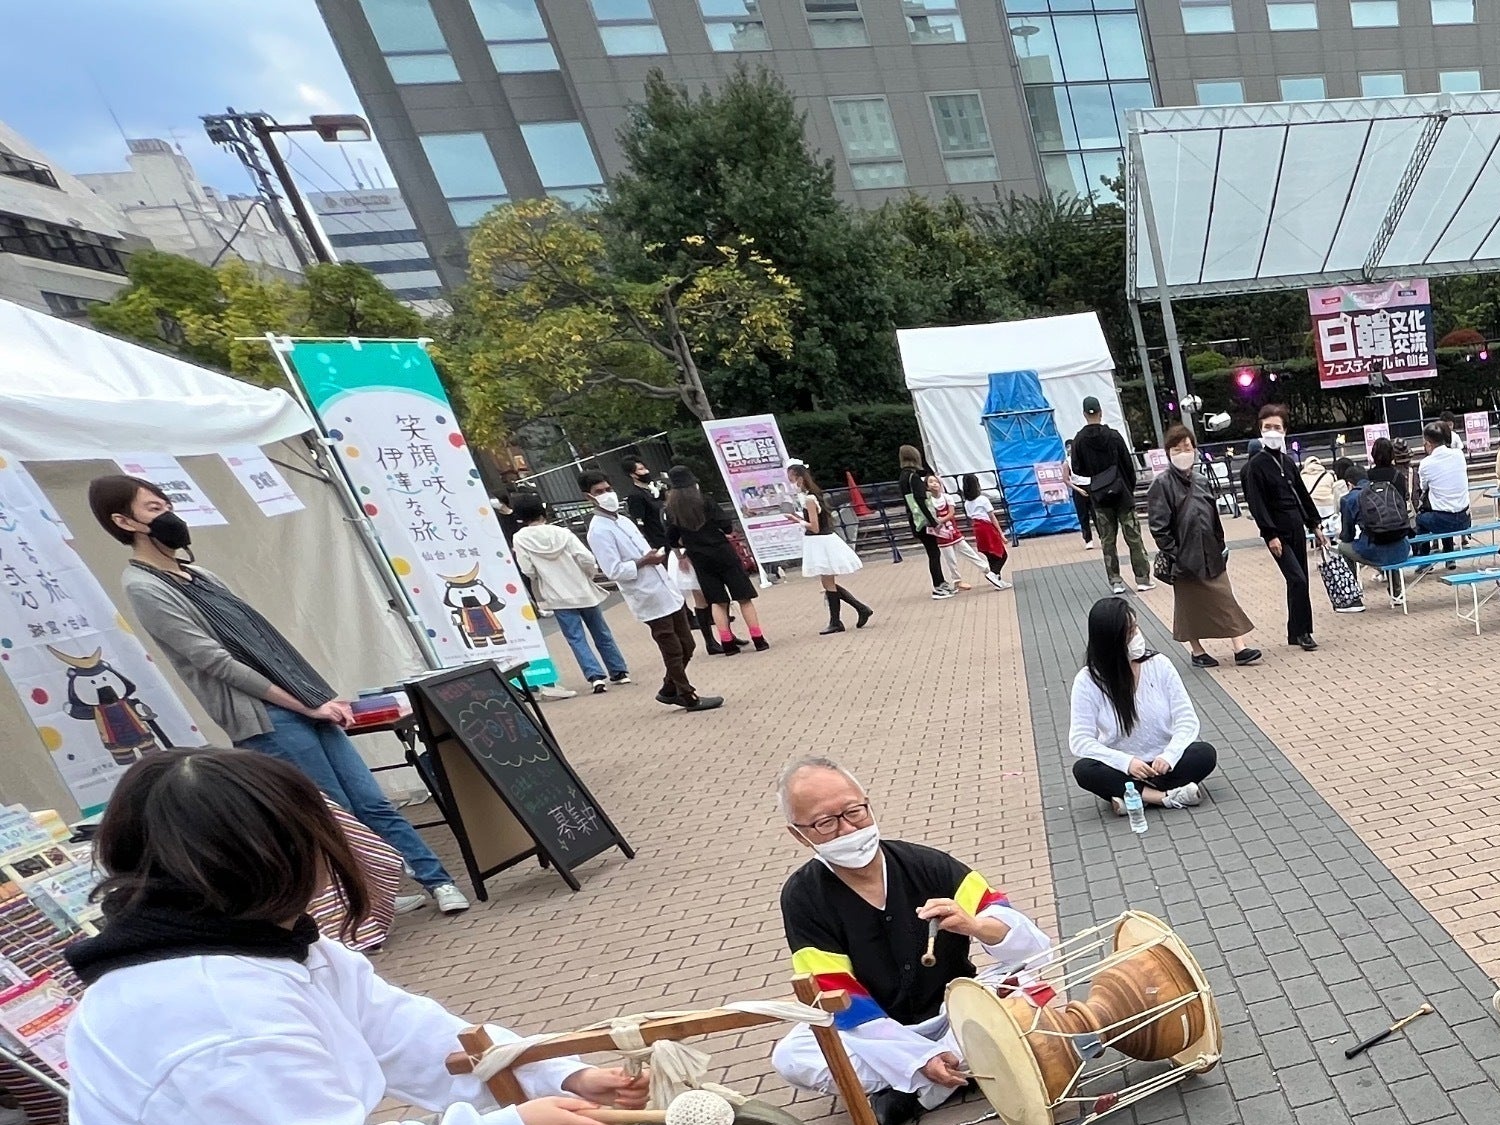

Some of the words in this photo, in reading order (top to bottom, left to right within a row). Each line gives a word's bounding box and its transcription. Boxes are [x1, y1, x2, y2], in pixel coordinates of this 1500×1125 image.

[1391, 309, 1426, 333] 文化
[1393, 331, 1428, 354] 交流
[1324, 356, 1394, 376] フェスティル
[1407, 353, 1429, 367] 仙台
[396, 414, 468, 541] 笑顔咲くたび
[375, 446, 445, 542] 伊達な旅
